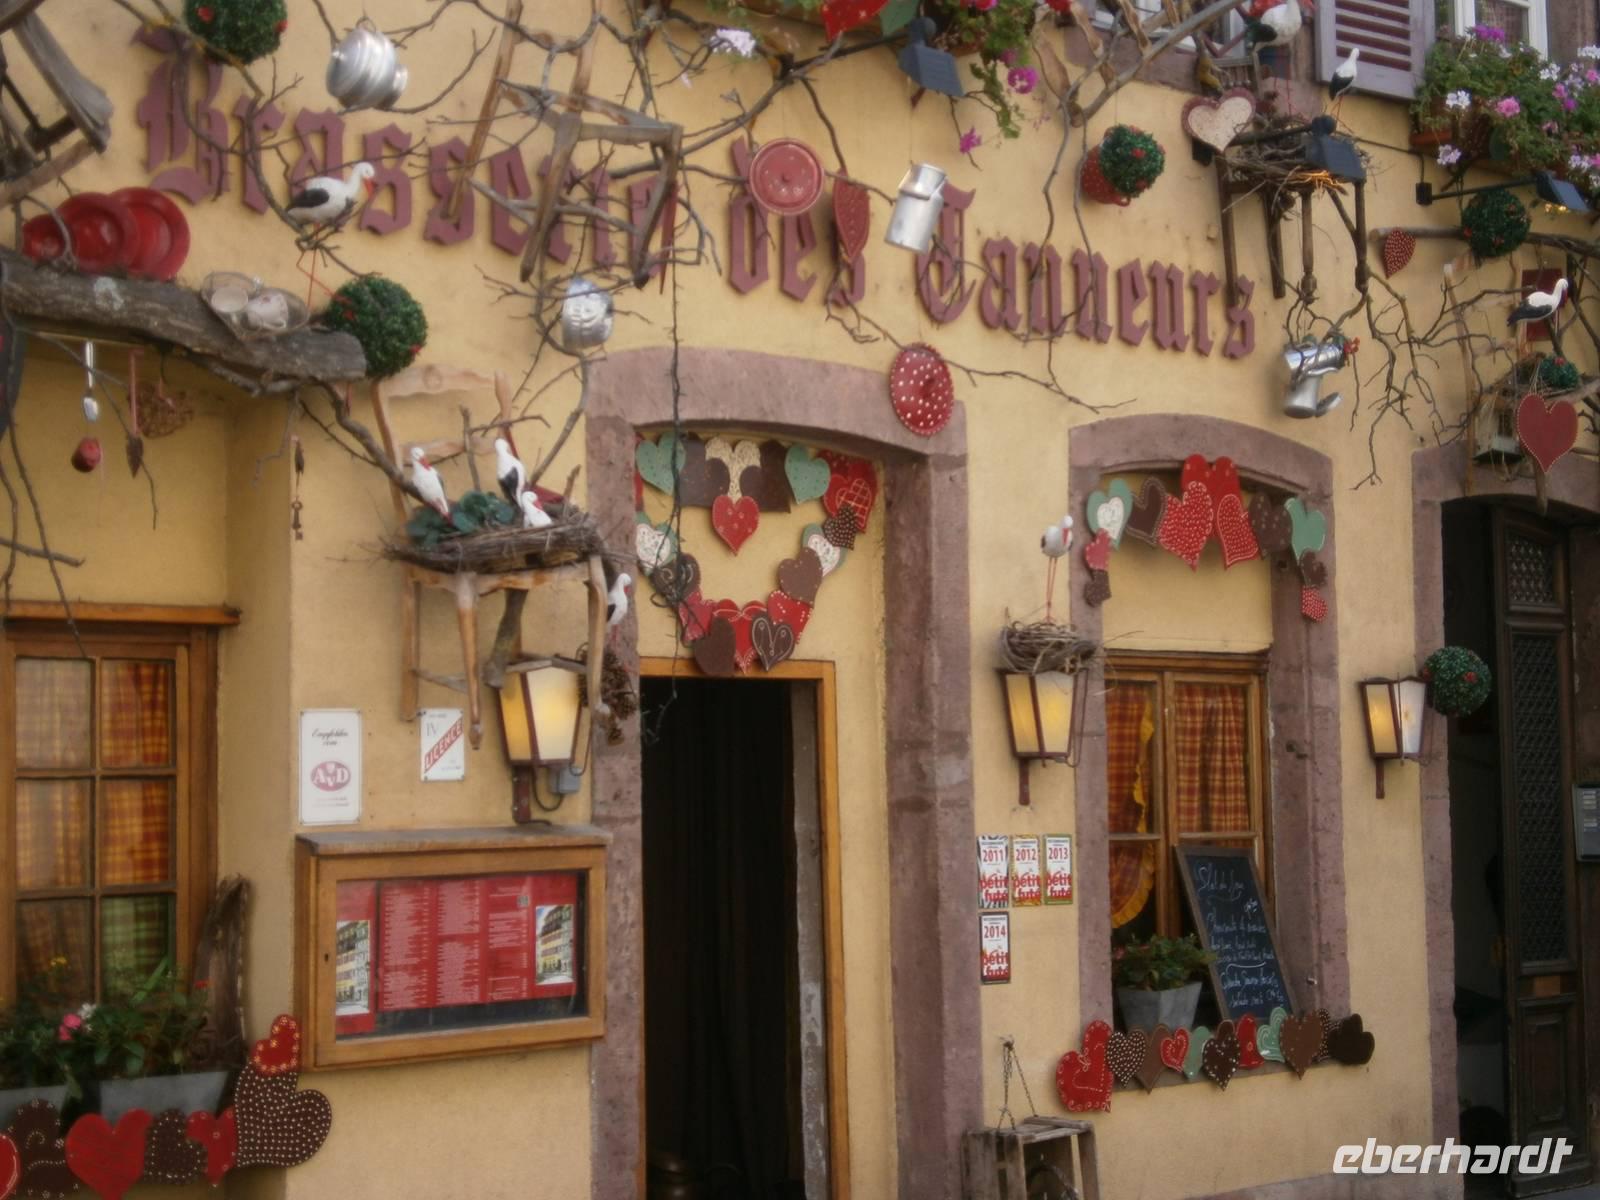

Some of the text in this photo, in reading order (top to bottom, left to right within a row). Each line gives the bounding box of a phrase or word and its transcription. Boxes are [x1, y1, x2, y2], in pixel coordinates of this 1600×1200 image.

[914, 181, 1256, 359] Tanneurs
[983, 848, 1004, 862] 2011
[1015, 848, 1037, 861] 2012
[1048, 847, 1068, 860] 2013
[983, 925, 1006, 939] 2014
